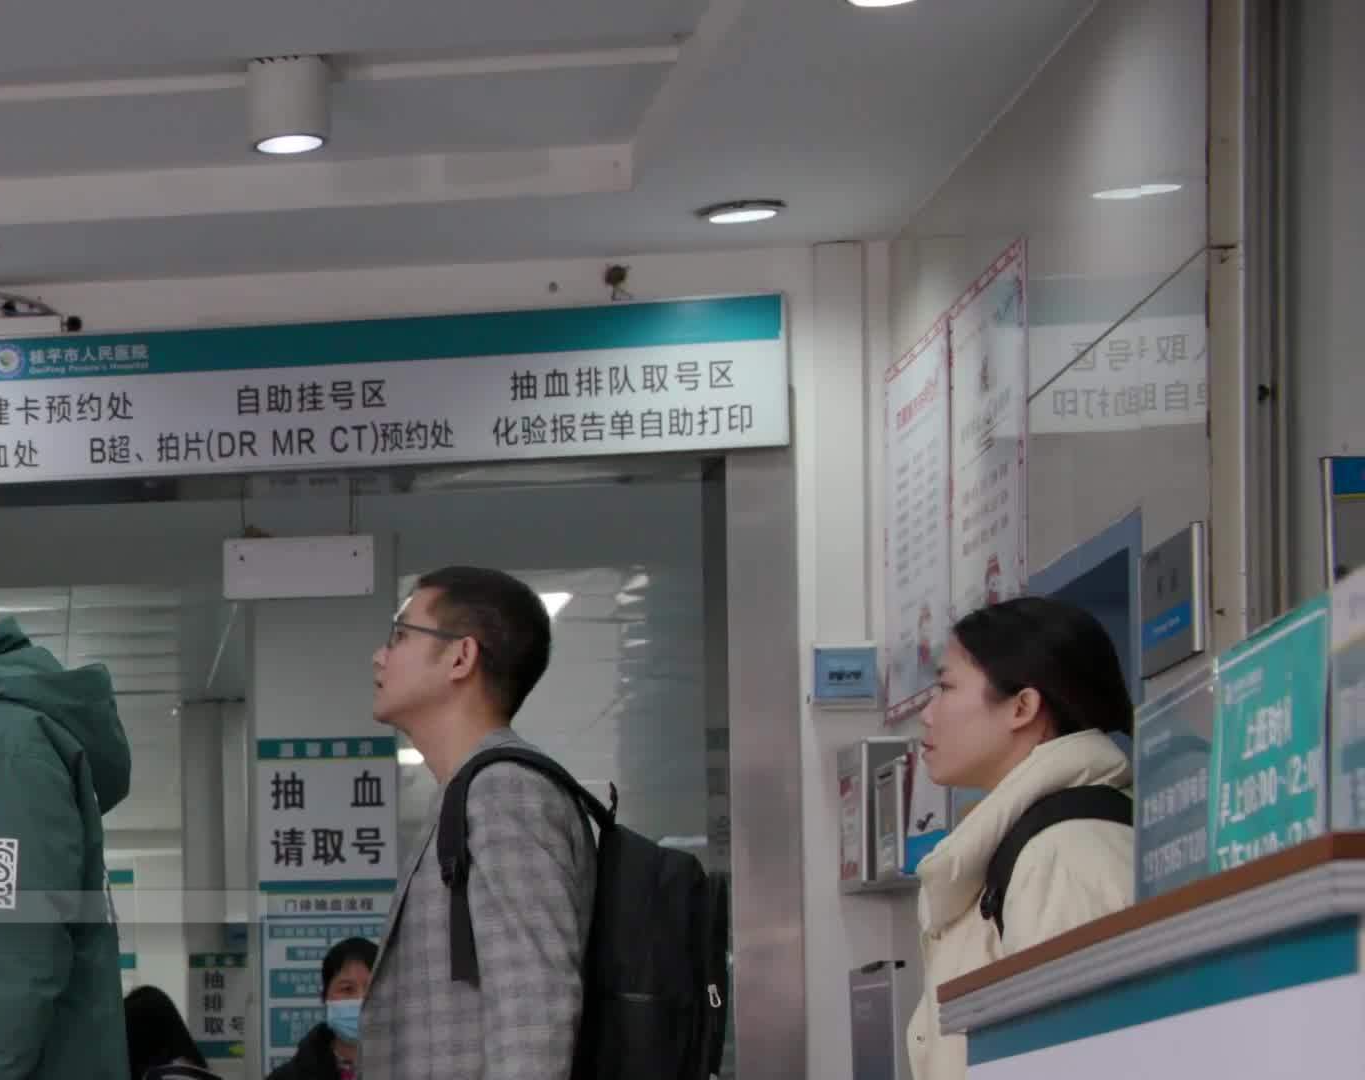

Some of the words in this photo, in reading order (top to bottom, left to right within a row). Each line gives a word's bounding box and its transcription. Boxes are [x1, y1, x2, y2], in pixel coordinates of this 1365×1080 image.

[237, 379, 387, 416] 自助挂号区
[510, 360, 734, 401] 抽血排队取号区
[272, 427, 316, 457] MR
[492, 403, 753, 446] 化验报告单自助打印
[271, 770, 386, 811] 抽血
[271, 827, 387, 868] 请取号
